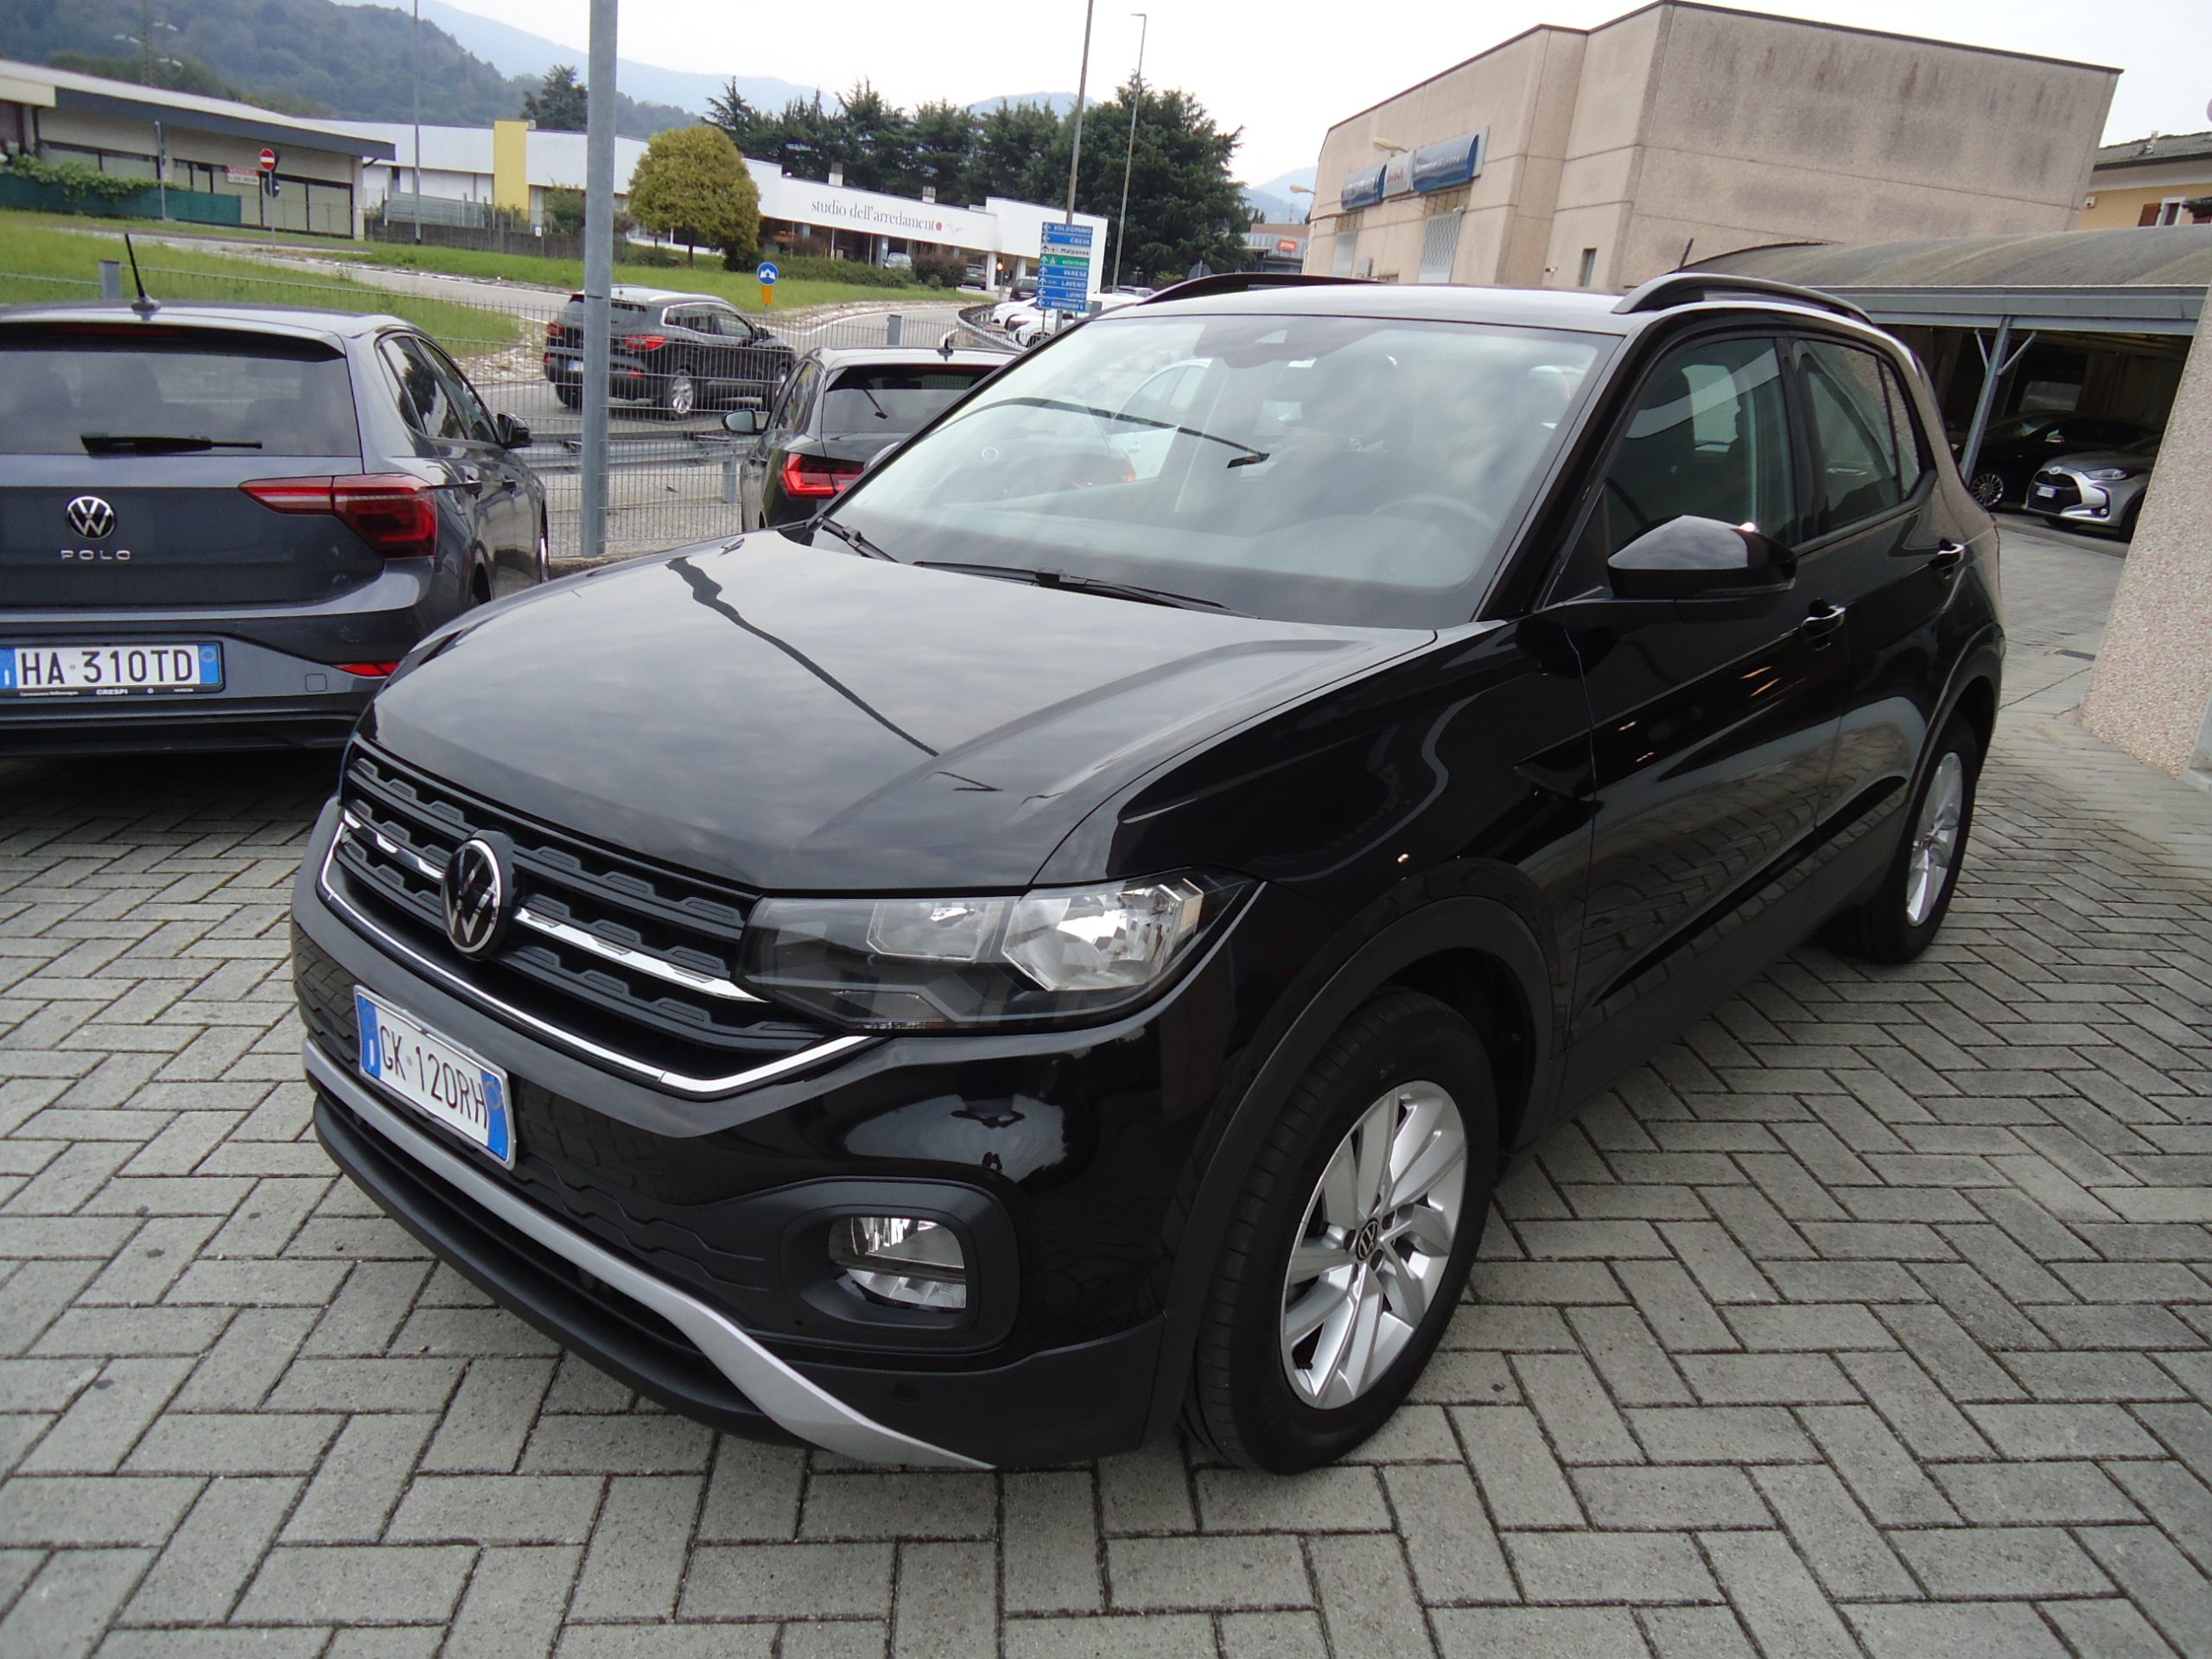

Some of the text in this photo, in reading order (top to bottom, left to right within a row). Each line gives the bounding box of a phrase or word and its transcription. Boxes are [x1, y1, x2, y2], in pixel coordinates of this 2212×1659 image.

[810, 200, 943, 231] studio dell'arredamento
[60, 550, 131, 561] POLO
[21, 651, 65, 685] HA
[81, 649, 193, 683] 310TD
[379, 1025, 407, 1082] GK
[416, 1046, 488, 1129] 120RH
